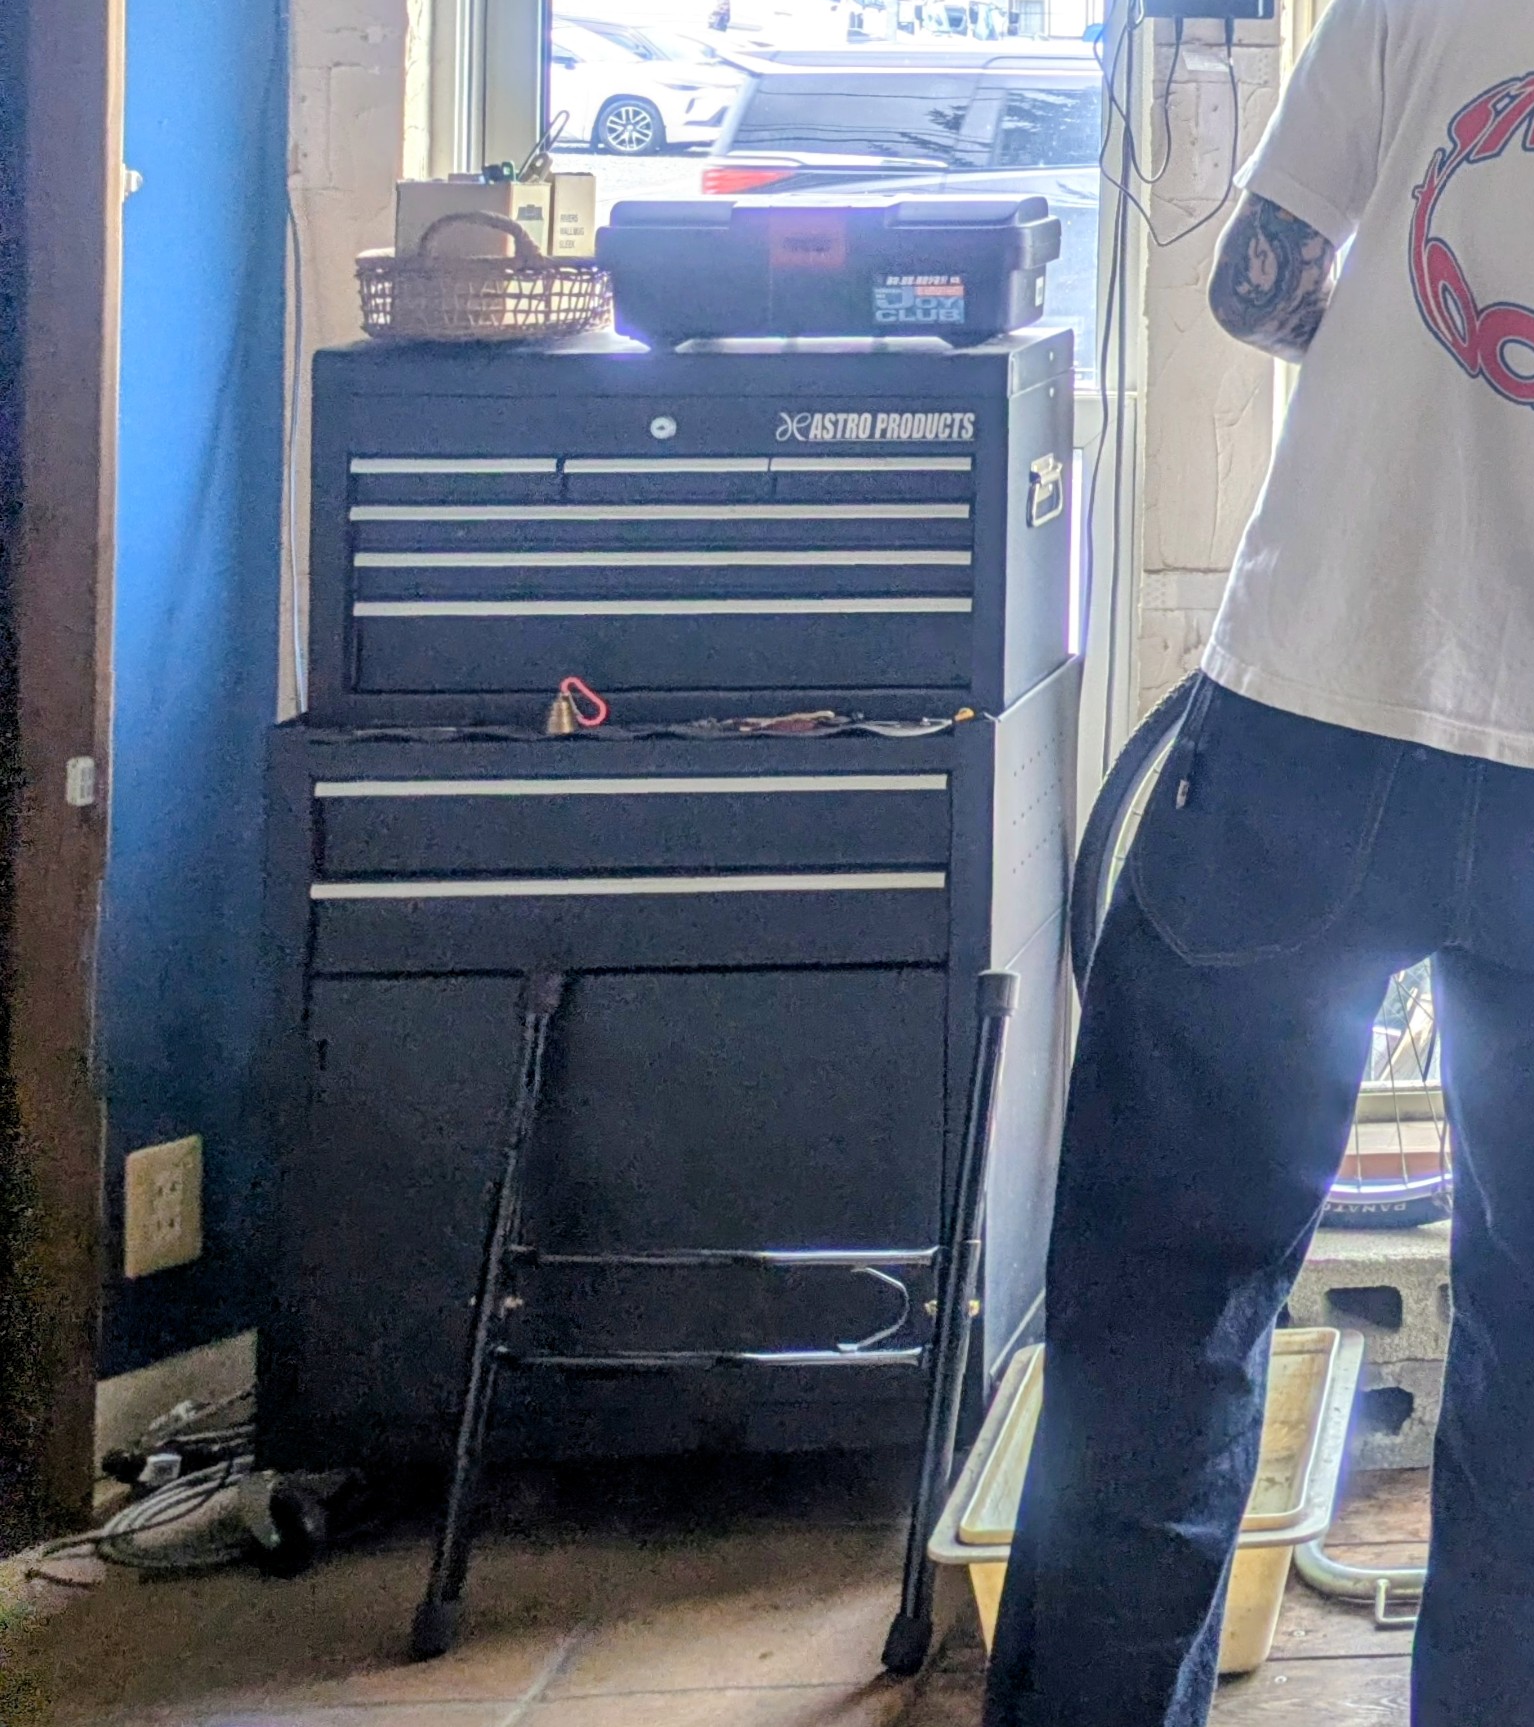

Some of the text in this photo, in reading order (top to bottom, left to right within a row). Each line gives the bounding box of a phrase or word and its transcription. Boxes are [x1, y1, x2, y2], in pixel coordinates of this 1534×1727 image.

[874, 285, 960, 309] JOY
[875, 309, 962, 322] CLUB
[809, 412, 975, 440] ASTRO PRODUCTS
